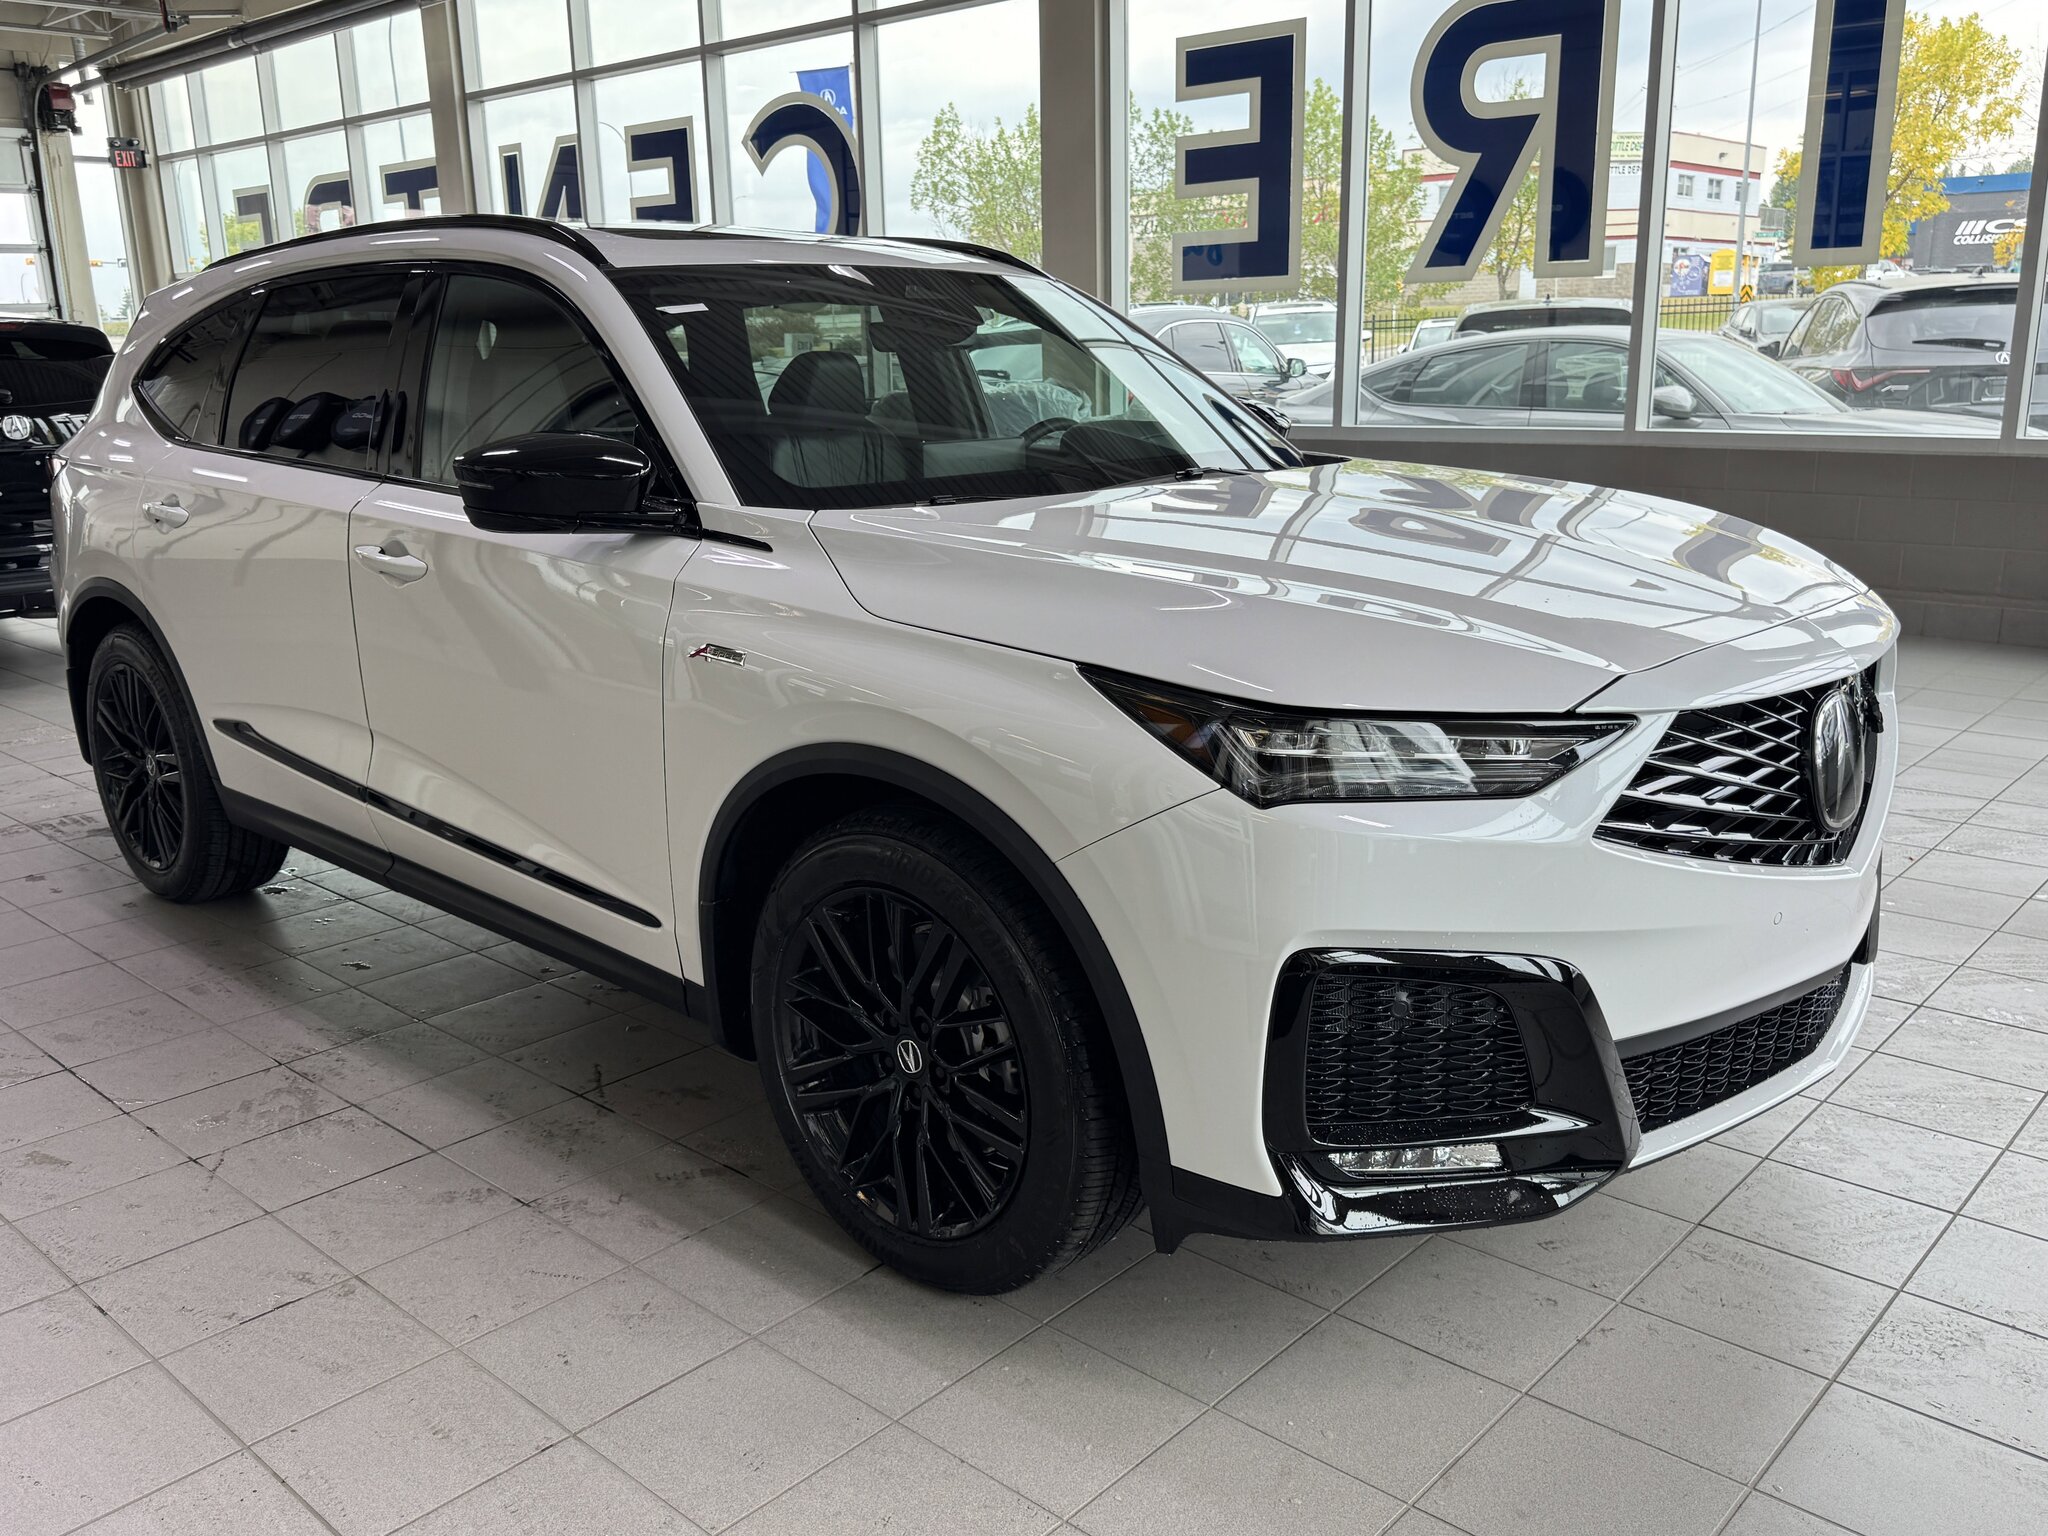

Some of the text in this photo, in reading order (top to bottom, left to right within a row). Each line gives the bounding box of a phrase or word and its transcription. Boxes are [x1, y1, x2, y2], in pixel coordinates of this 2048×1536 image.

[114, 150, 137, 167] EXIT
[1610, 165, 1641, 175] TTLE DEP
[1953, 234, 2007, 245] COLLISI
